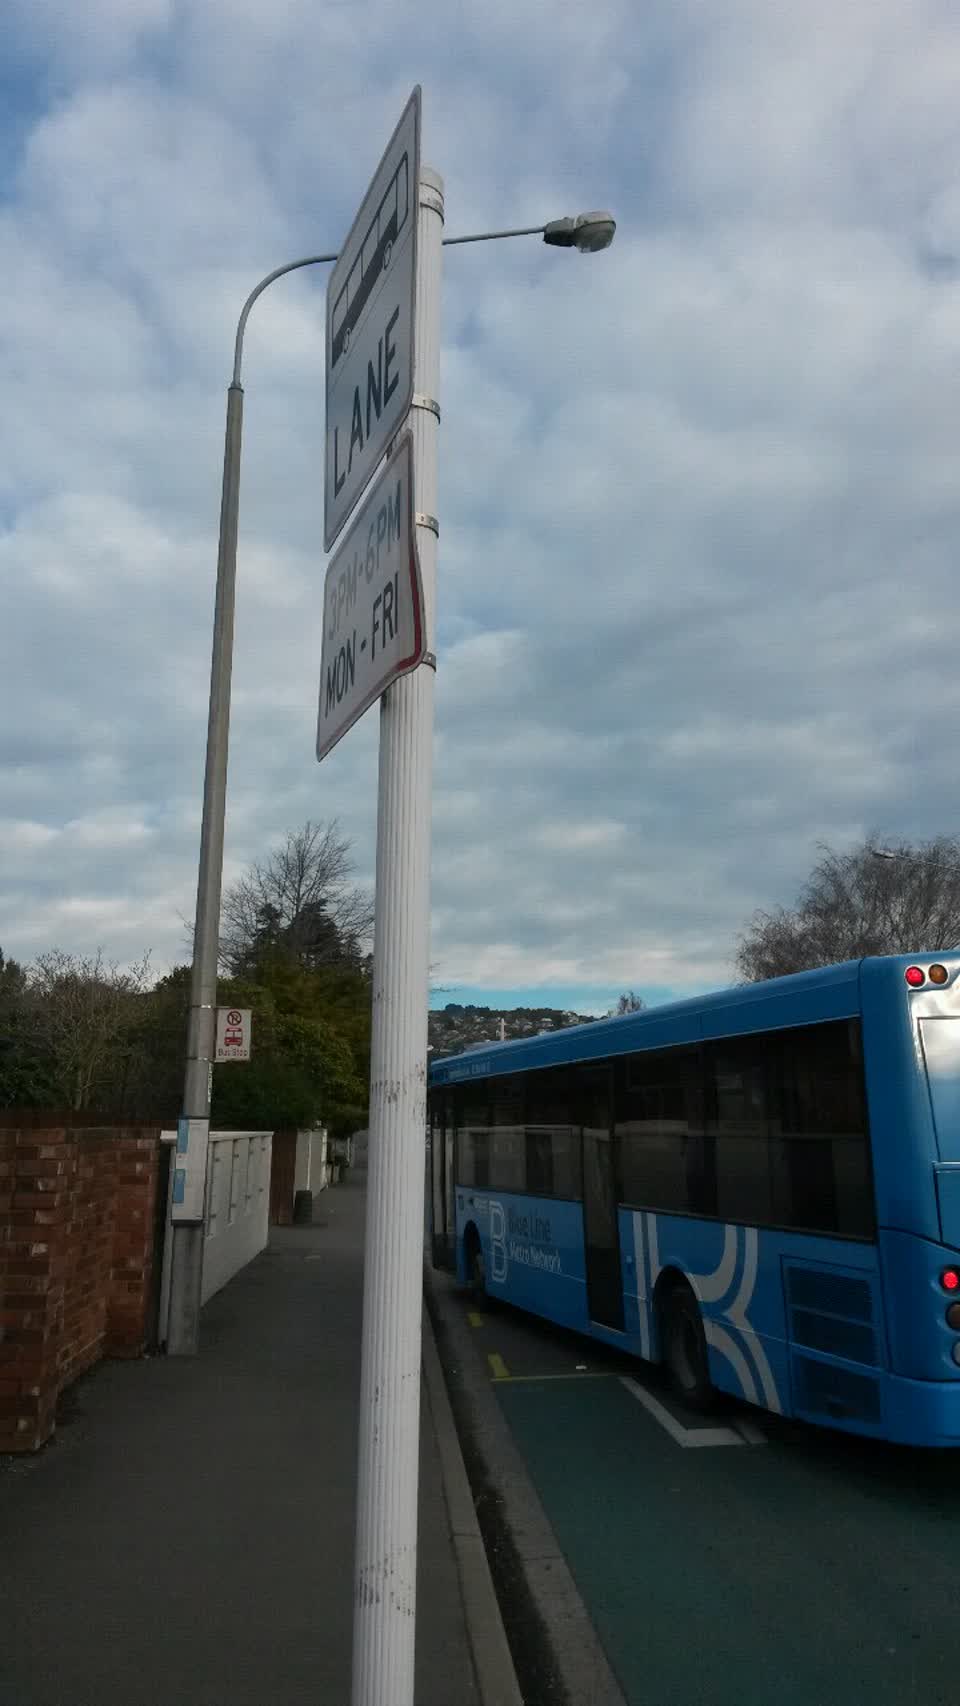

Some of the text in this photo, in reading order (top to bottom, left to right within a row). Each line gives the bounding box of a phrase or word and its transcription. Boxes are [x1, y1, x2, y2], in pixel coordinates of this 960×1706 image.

[334, 304, 400, 498] LANE
[325, 629, 356, 718] MON
[372, 573, 398, 660] FRI
